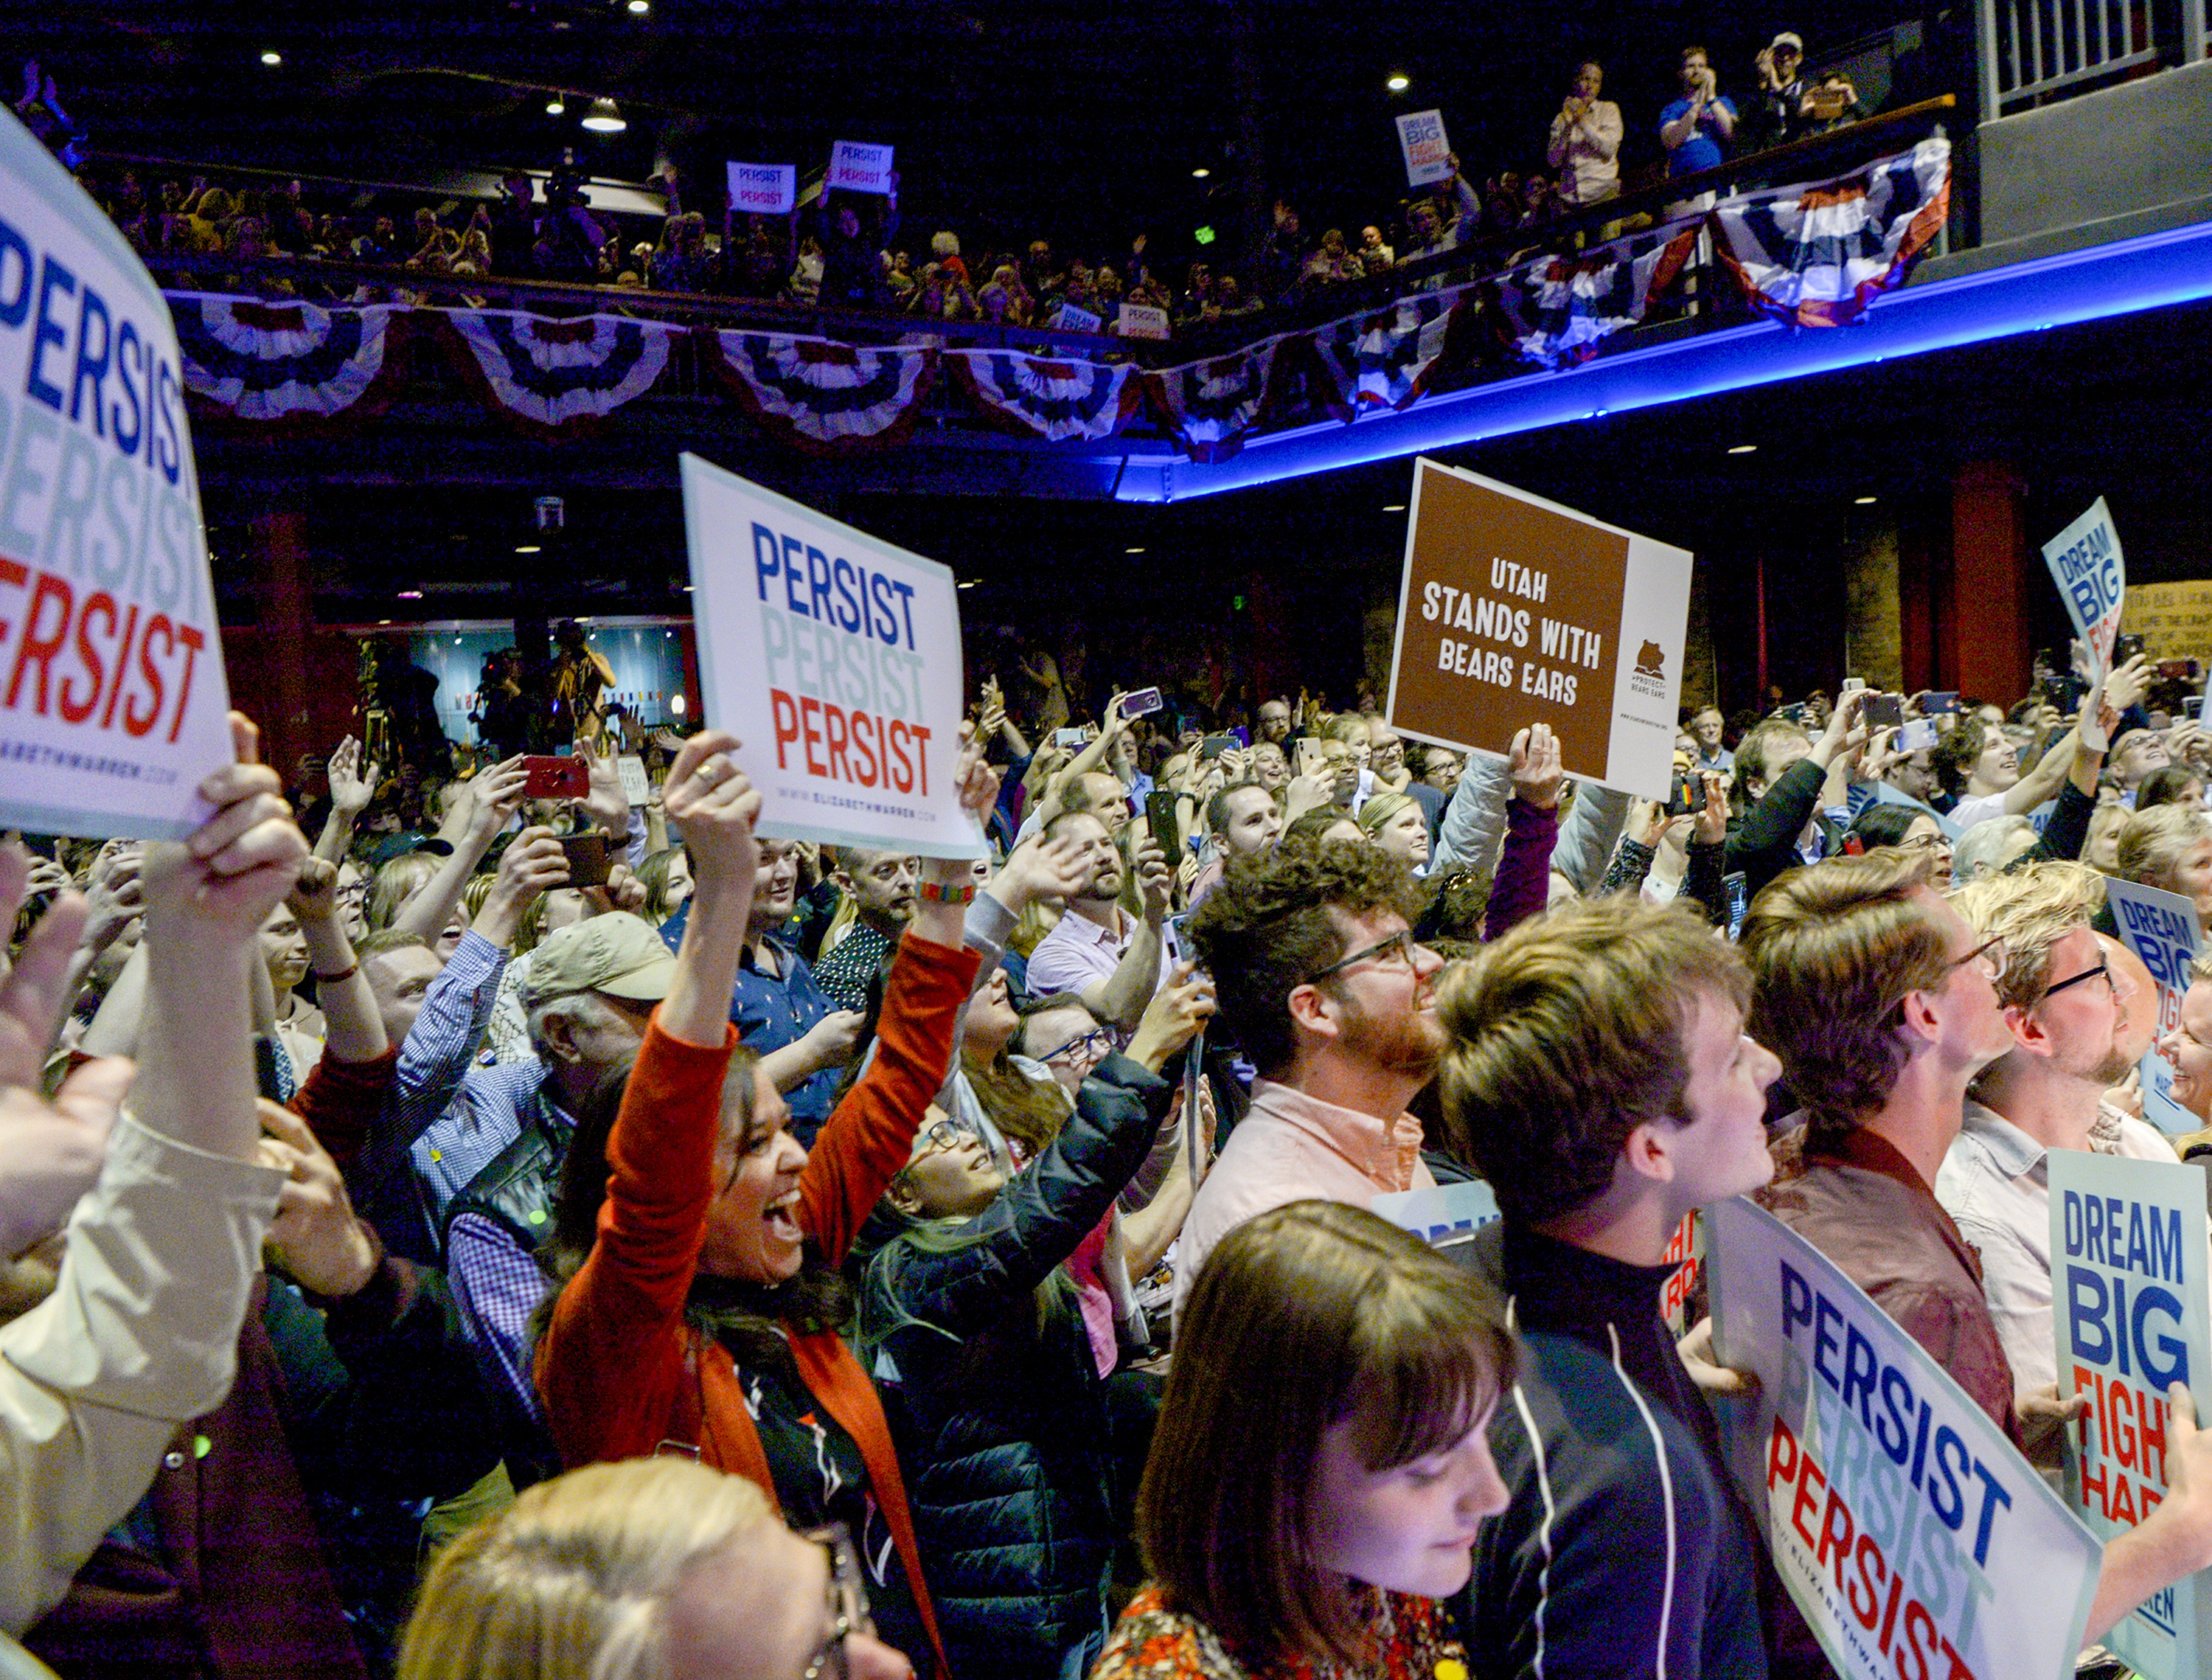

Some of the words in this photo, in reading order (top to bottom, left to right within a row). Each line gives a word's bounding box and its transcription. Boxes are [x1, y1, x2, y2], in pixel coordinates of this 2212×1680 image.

[841, 145, 883, 162] PERSIST
[1405, 126, 1441, 145] BIG
[740, 168, 783, 184] PERSIST
[740, 190, 783, 205] PERSIST
[838, 167, 880, 184] PERSIST
[0, 407, 199, 623] ERSIST
[751, 521, 915, 652] PERSIST
[1491, 556, 1548, 603] UTAH
[2057, 521, 2112, 586] DREAM
[1422, 580, 1531, 648] STANDS
[1540, 617, 1601, 670] WITH
[2070, 558, 2120, 628] BIG
[759, 603, 926, 723] PERSIST
[1438, 638, 1514, 689] BEARS
[1520, 662, 1578, 707] EARS
[770, 687, 932, 797] PERSIST
[2119, 898, 2195, 951] DREAM
[2064, 1190, 2184, 1285] DREAM
[2067, 1263, 2190, 1393] BIG
[1779, 1257, 2012, 1569] PERSIST
[2073, 1364, 2171, 1488] FIGH
